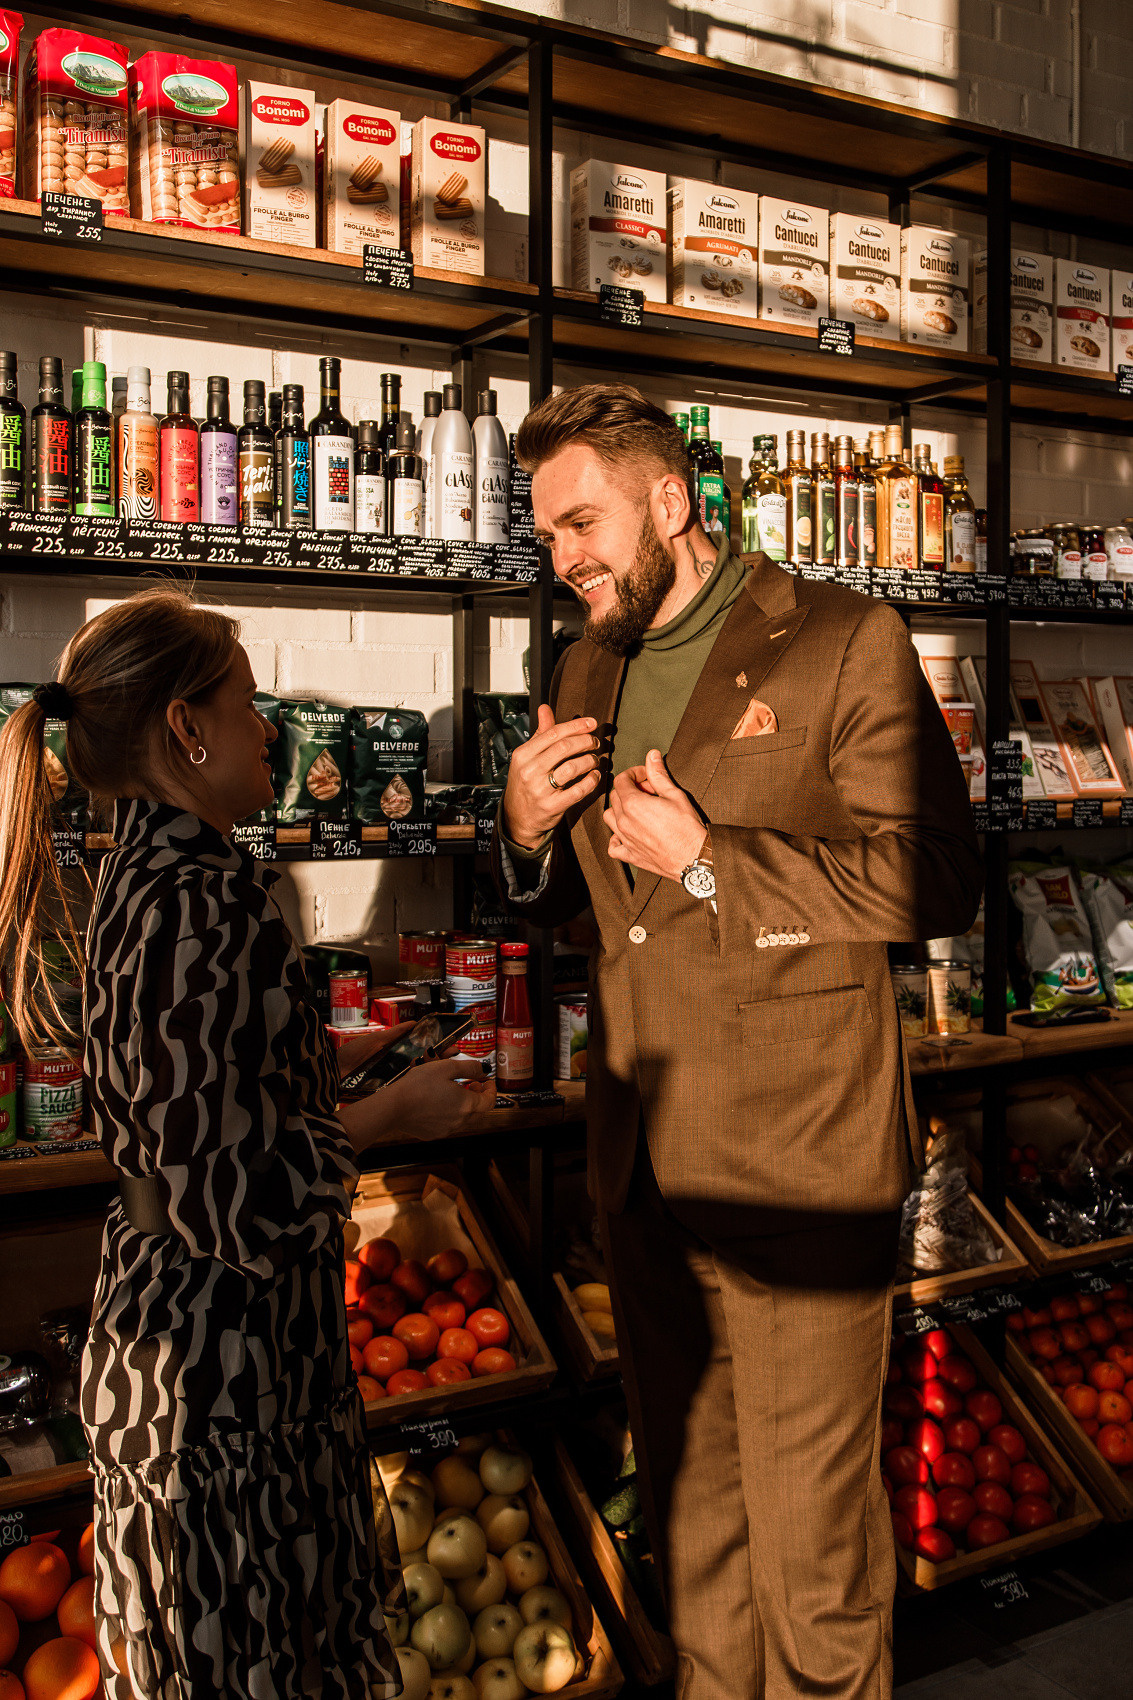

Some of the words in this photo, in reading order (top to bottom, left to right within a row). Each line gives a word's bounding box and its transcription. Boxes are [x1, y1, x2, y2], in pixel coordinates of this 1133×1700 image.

[270, 99, 291, 108] FORNO
[256, 103, 305, 119] Bonomi
[360, 118, 380, 126] FORNO
[348, 122, 393, 138] Bonomi
[446, 136, 465, 144] FORNO
[434, 139, 478, 156] Bonomi
[45, 192, 92, 208] ПЕЧЕНЬЕ
[604, 190, 654, 215] Amaretti
[254, 207, 278, 216] FROLLE
[288, 212, 310, 220] BURRO
[614, 222, 644, 234] CLASSICI
[698, 211, 746, 234] Amaretti
[344, 222, 366, 232] FROLLE
[377, 227, 396, 238] BURRO
[360, 230, 380, 239] FINGER
[774, 224, 818, 248] Cantucci
[430, 237, 454, 246] FROLLE
[463, 242, 480, 251] BURRO
[446, 244, 466, 254] FINGER
[706, 241, 739, 253] AGRUMATI
[368, 245, 406, 260] ПЕЧЕНЬЕ
[848, 240, 890, 262] Cantucci
[782, 254, 812, 266] MANDORLE
[920, 254, 959, 276] Cantucci
[855, 268, 884, 280] MANDORLE
[602, 284, 632, 298] ПЕЧЕНЬЕ
[1067, 283, 1102, 303] Cantucci
[300, 712, 345, 722] DELVERDE
[373, 742, 420, 751] DELVERDE
[320, 822, 351, 832] ПЕННЕ
[462, 1030, 494, 1041] MUTTI
[512, 1031, 532, 1039] MUTTI
[43, 1064, 74, 1074] MUTTI
[40, 1085, 76, 1104] PIZZA
[40, 1100, 77, 1114] SAUCE
